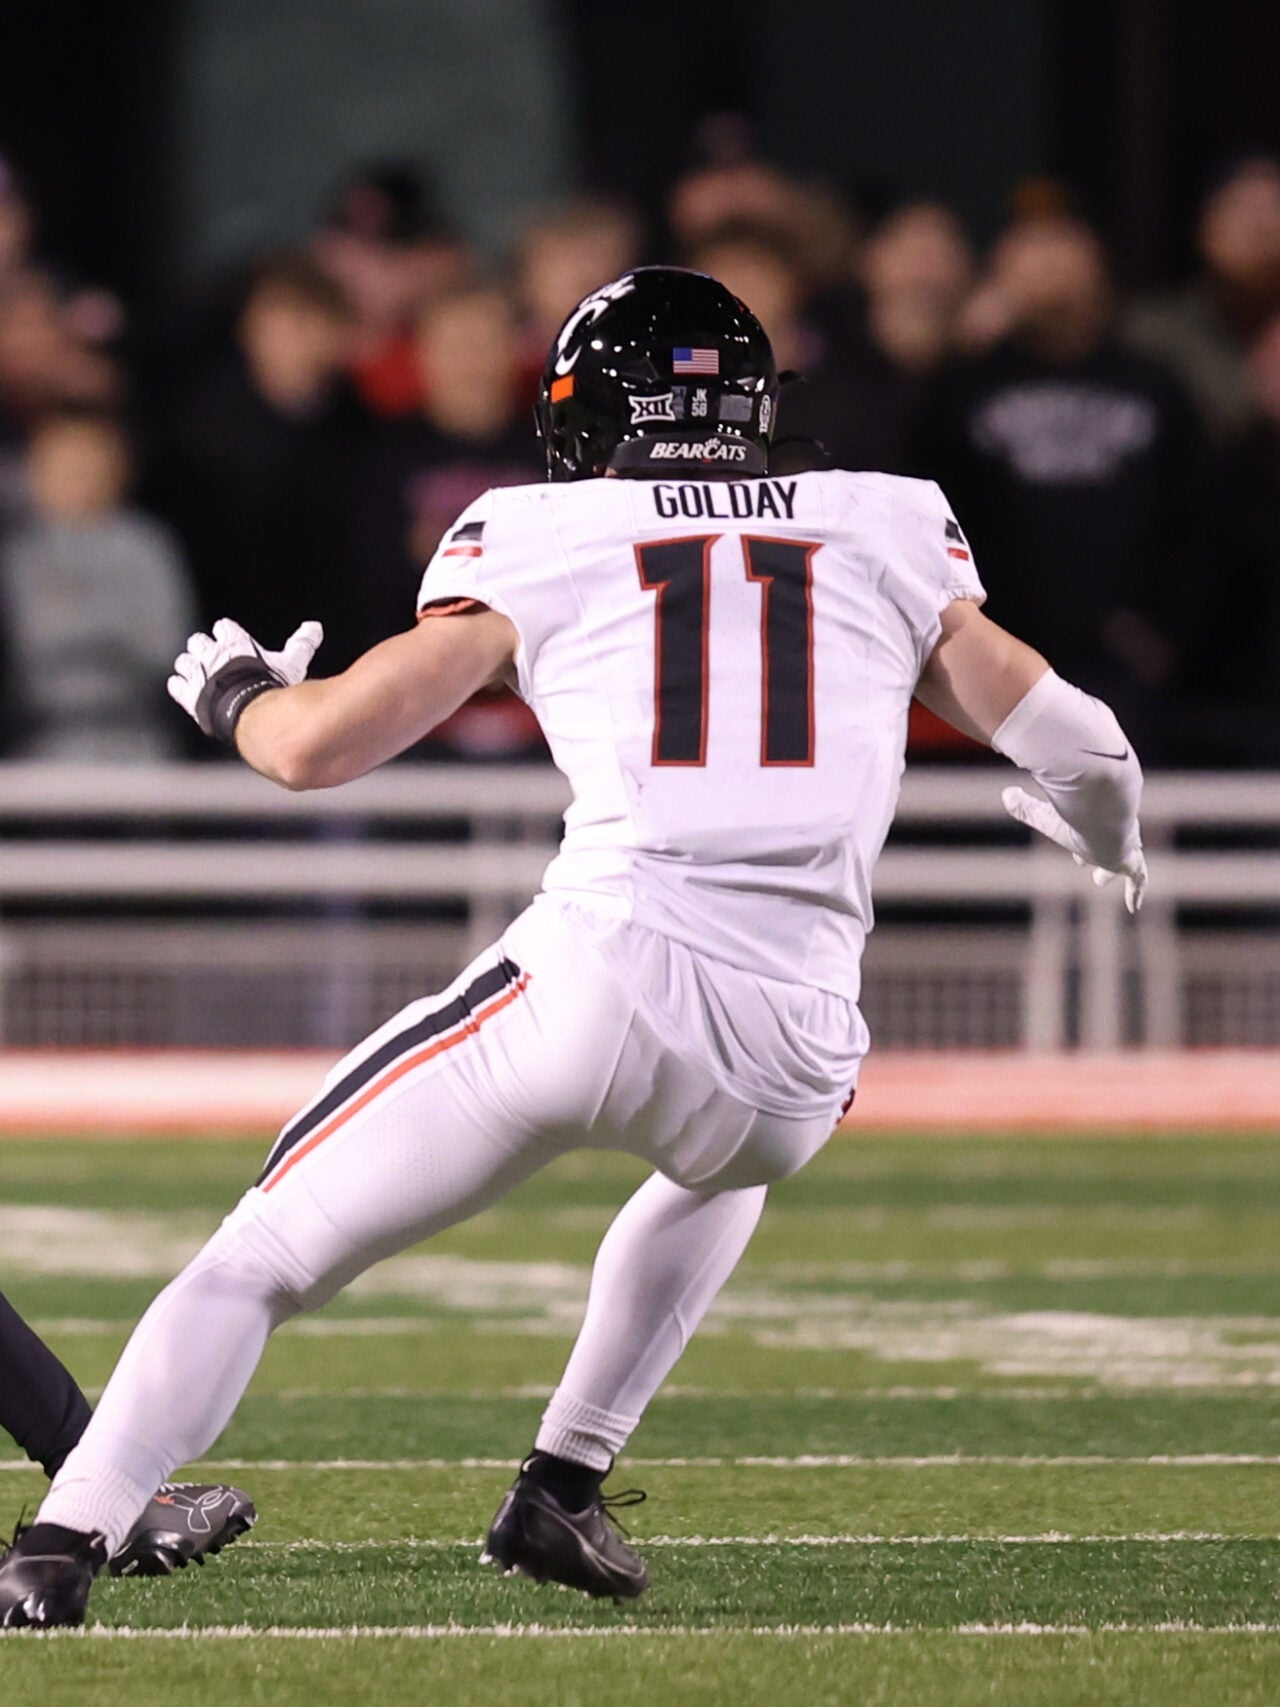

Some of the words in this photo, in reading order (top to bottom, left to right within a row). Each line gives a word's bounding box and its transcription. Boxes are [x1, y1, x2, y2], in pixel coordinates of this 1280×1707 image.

[650, 442, 746, 461] BEARCATS
[654, 481, 796, 519] GOLDAY
[633, 533, 825, 767] 11
